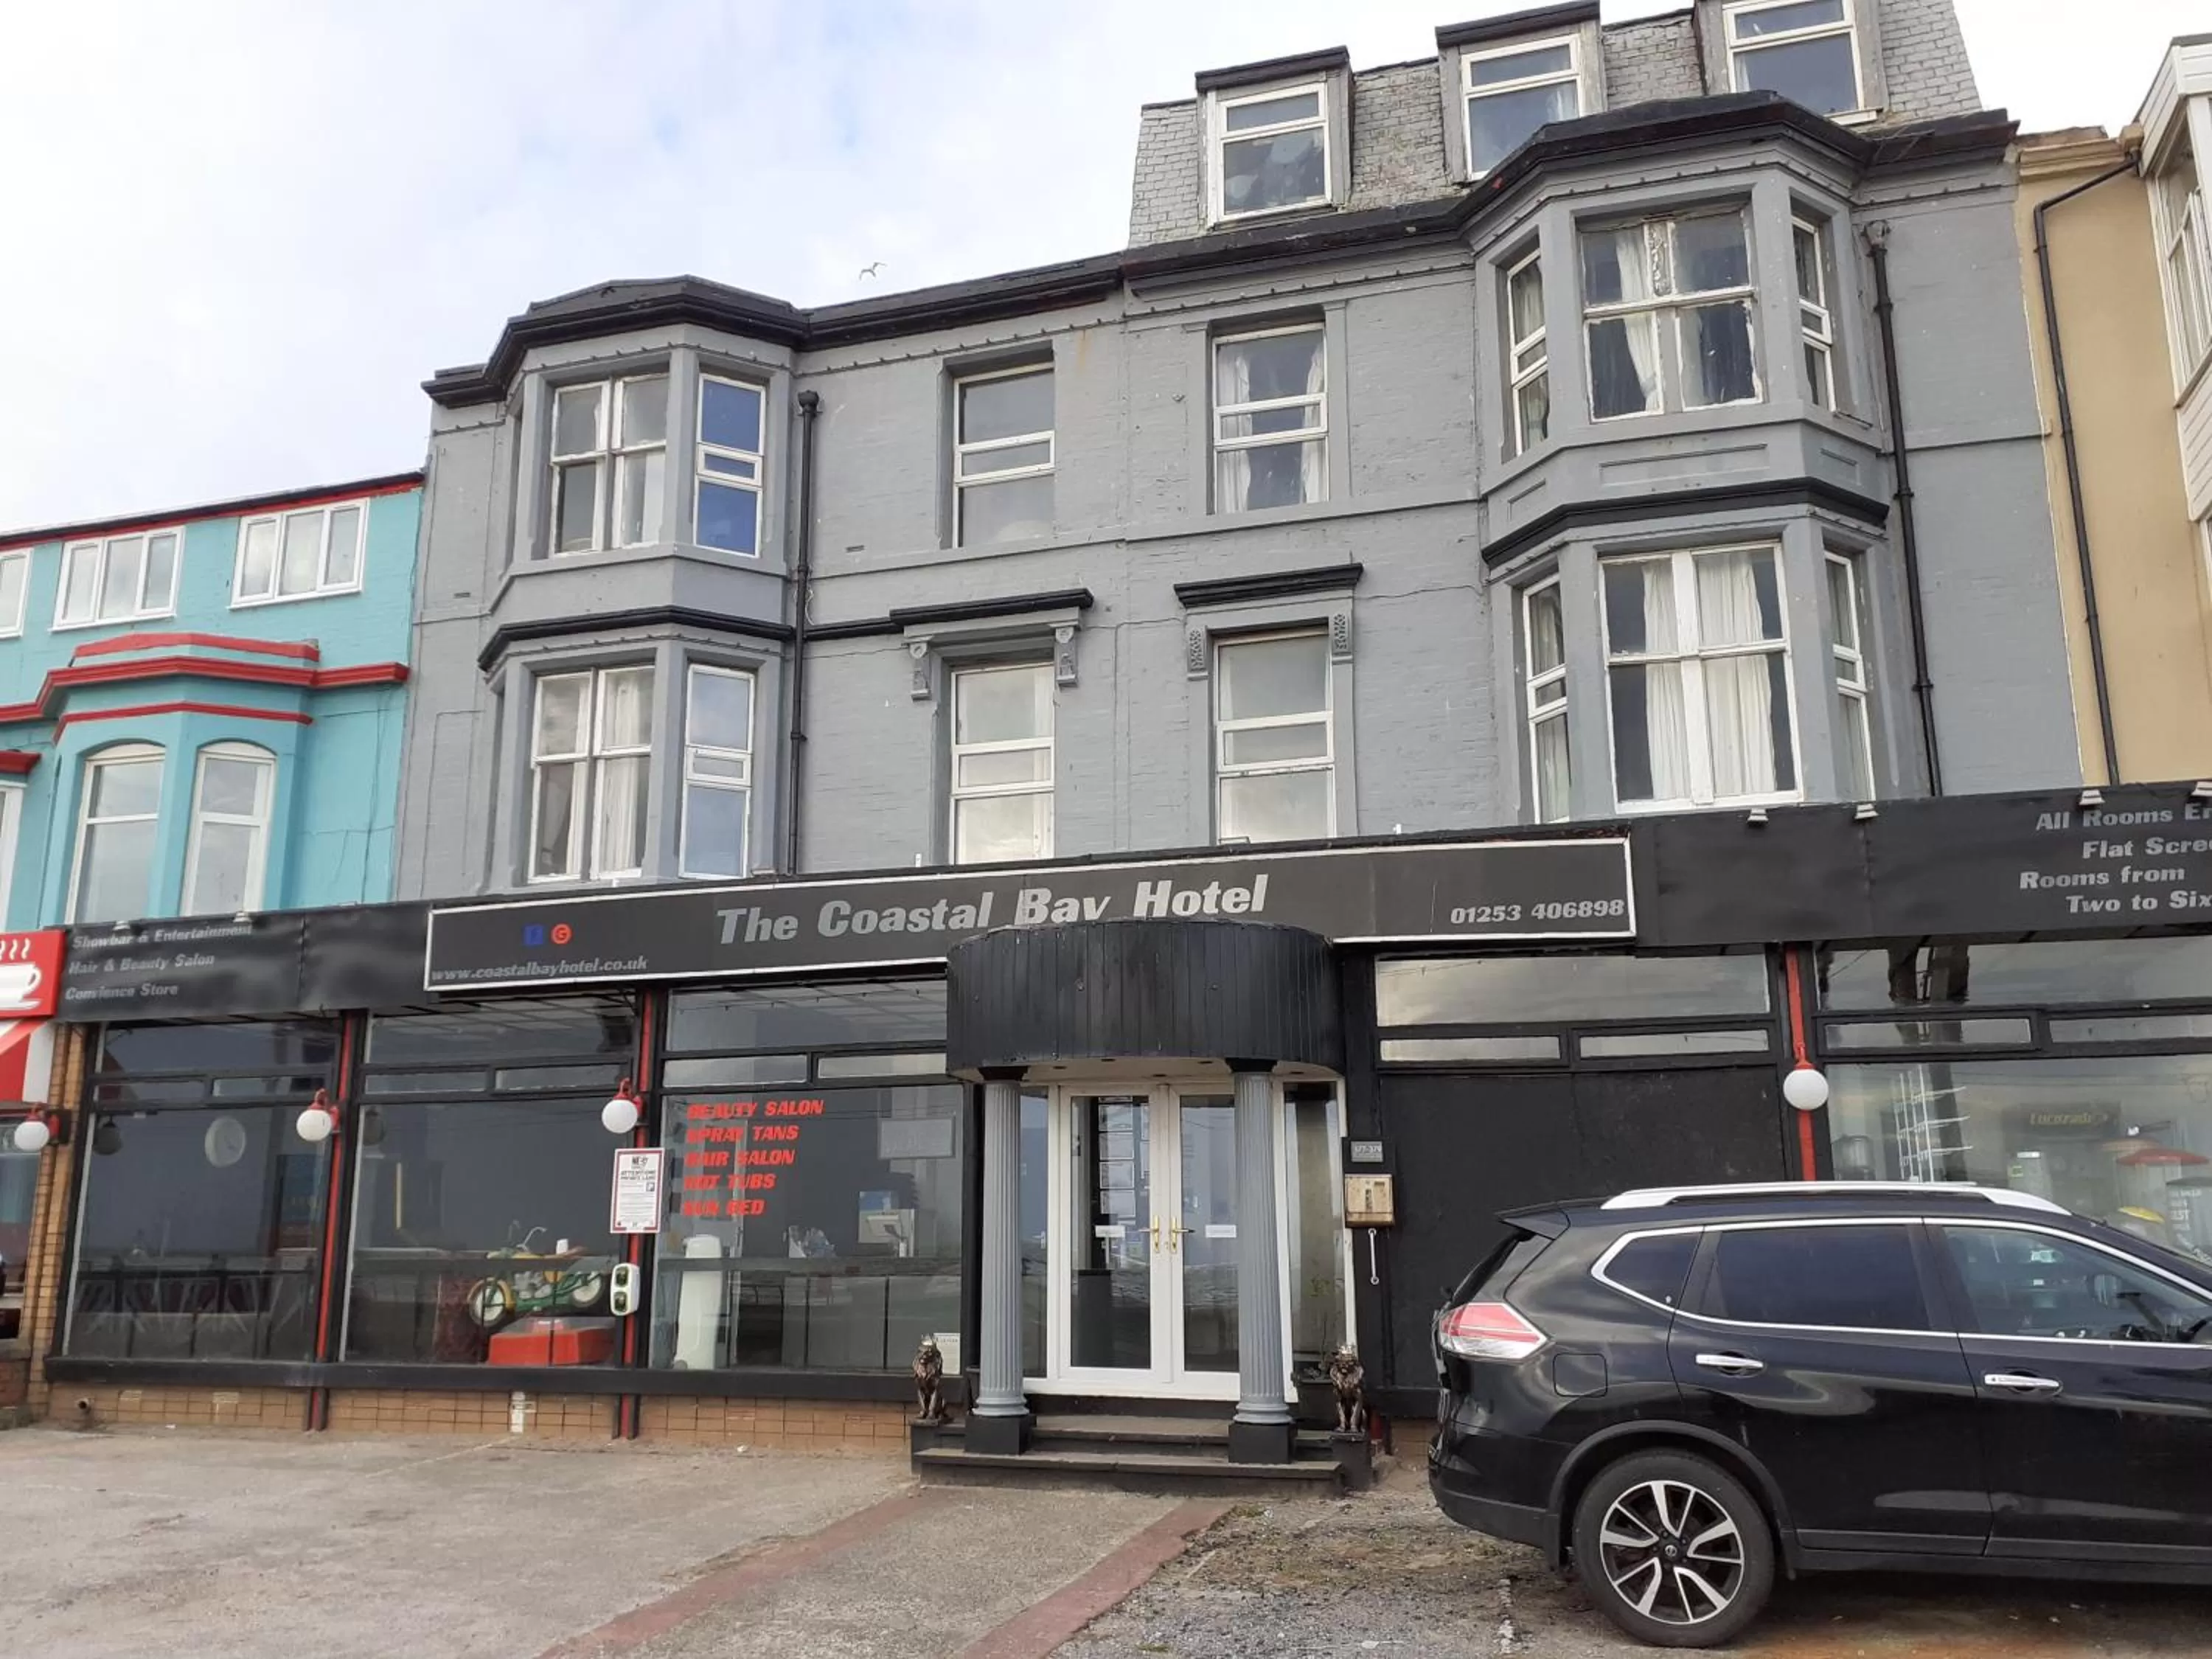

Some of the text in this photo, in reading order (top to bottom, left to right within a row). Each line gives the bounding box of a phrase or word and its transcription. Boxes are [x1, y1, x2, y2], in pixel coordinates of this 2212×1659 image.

[2036, 812, 2070, 830] All
[2082, 809, 2173, 827] Rooms
[2082, 837, 2212, 859] Flat Scre
[2020, 865, 2185, 890] Rooms from
[717, 907, 799, 945] The
[817, 891, 995, 937] Coastal
[1133, 874, 1269, 919] Hotel
[1450, 899, 1625, 924] 01253 406898
[2065, 890, 2212, 914] Two to Six
[73, 934, 133, 949] Showbar
[154, 925, 252, 942] Entertainment
[69, 953, 215, 974] Hair & Beauty Salon
[431, 956, 648, 980] www.coastalbayhotel.co.uk
[139, 983, 178, 996] Store
[686, 1099, 824, 1119] BEAUTY SALON
[686, 1124, 799, 1143] SPRAY TANS
[737, 1150, 795, 1166] SALON
[728, 1173, 776, 1189] TUBS
